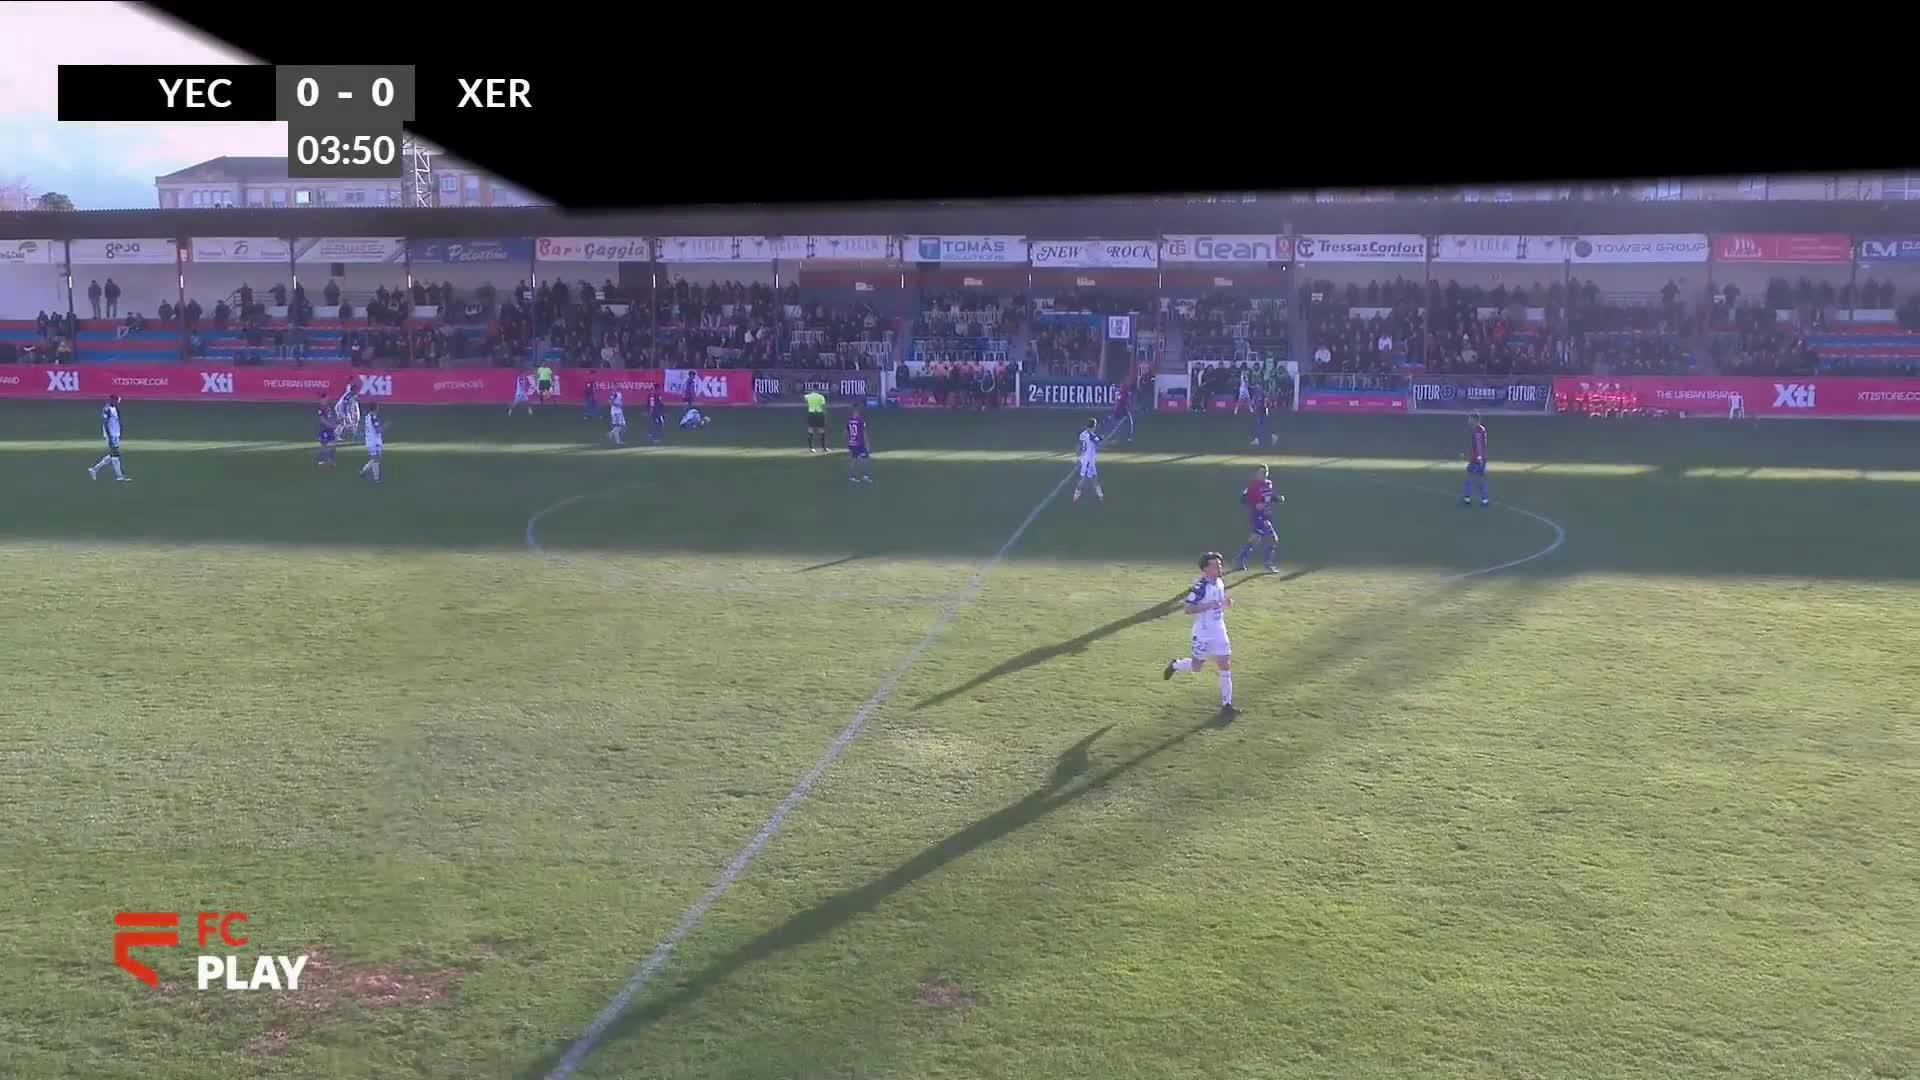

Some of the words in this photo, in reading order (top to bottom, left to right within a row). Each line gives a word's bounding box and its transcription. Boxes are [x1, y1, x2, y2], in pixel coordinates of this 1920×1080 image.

[539, 238, 572, 257] Bar
[942, 238, 1005, 252] TOMÁS
[1036, 246, 1082, 261] NEW
[1105, 245, 1157, 261] ROCK
[1194, 237, 1272, 259] Gean
[1595, 243, 1651, 254] TOWER
[1655, 242, 1706, 254] GROUP
[47, 371, 80, 392] Xti
[201, 373, 233, 393] Xti
[359, 374, 392, 396] Xti
[1656, 389, 1673, 399] THE
[1772, 384, 1816, 408] Xti
